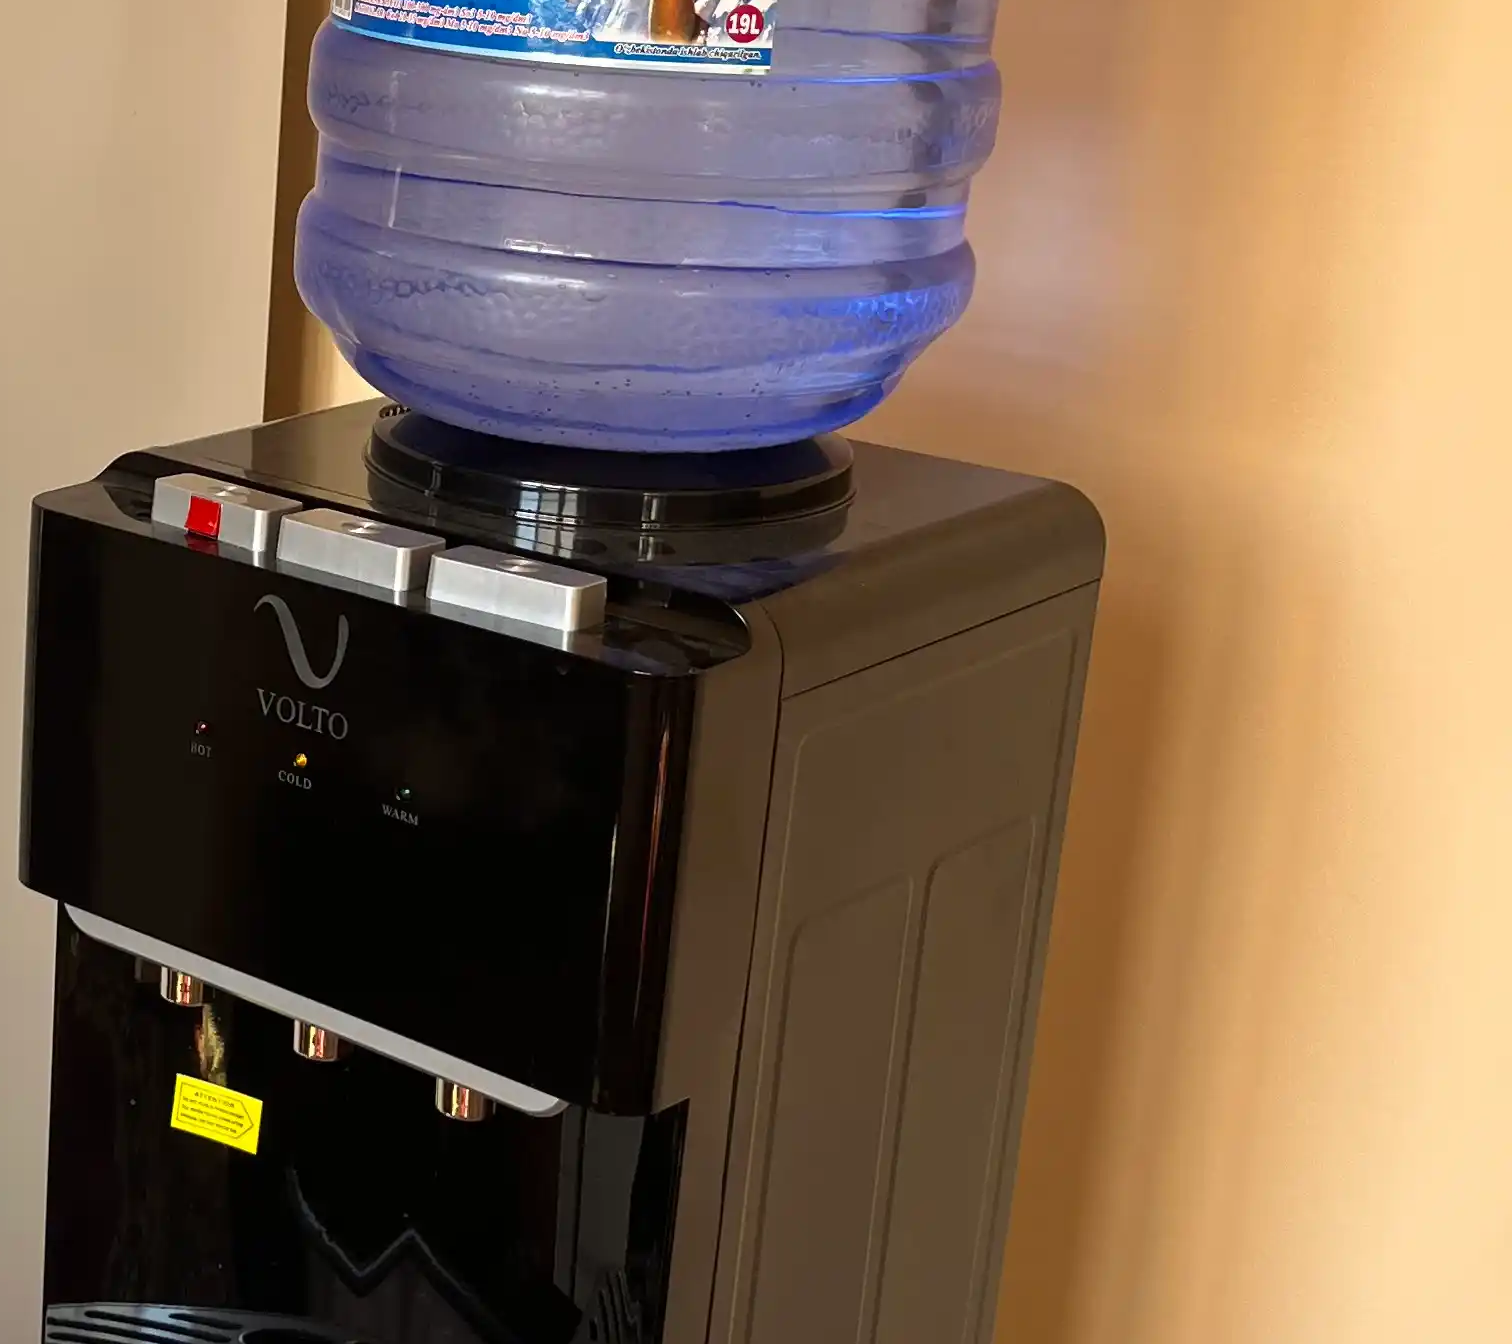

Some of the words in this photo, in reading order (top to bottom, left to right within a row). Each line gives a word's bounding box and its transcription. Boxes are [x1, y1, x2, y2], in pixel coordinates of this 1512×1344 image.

[728, 13, 761, 35] 19L
[256, 687, 349, 740] VOLTO
[190, 741, 212, 758] HOT
[278, 769, 313, 791] COLD
[381, 803, 419, 827] WARM
